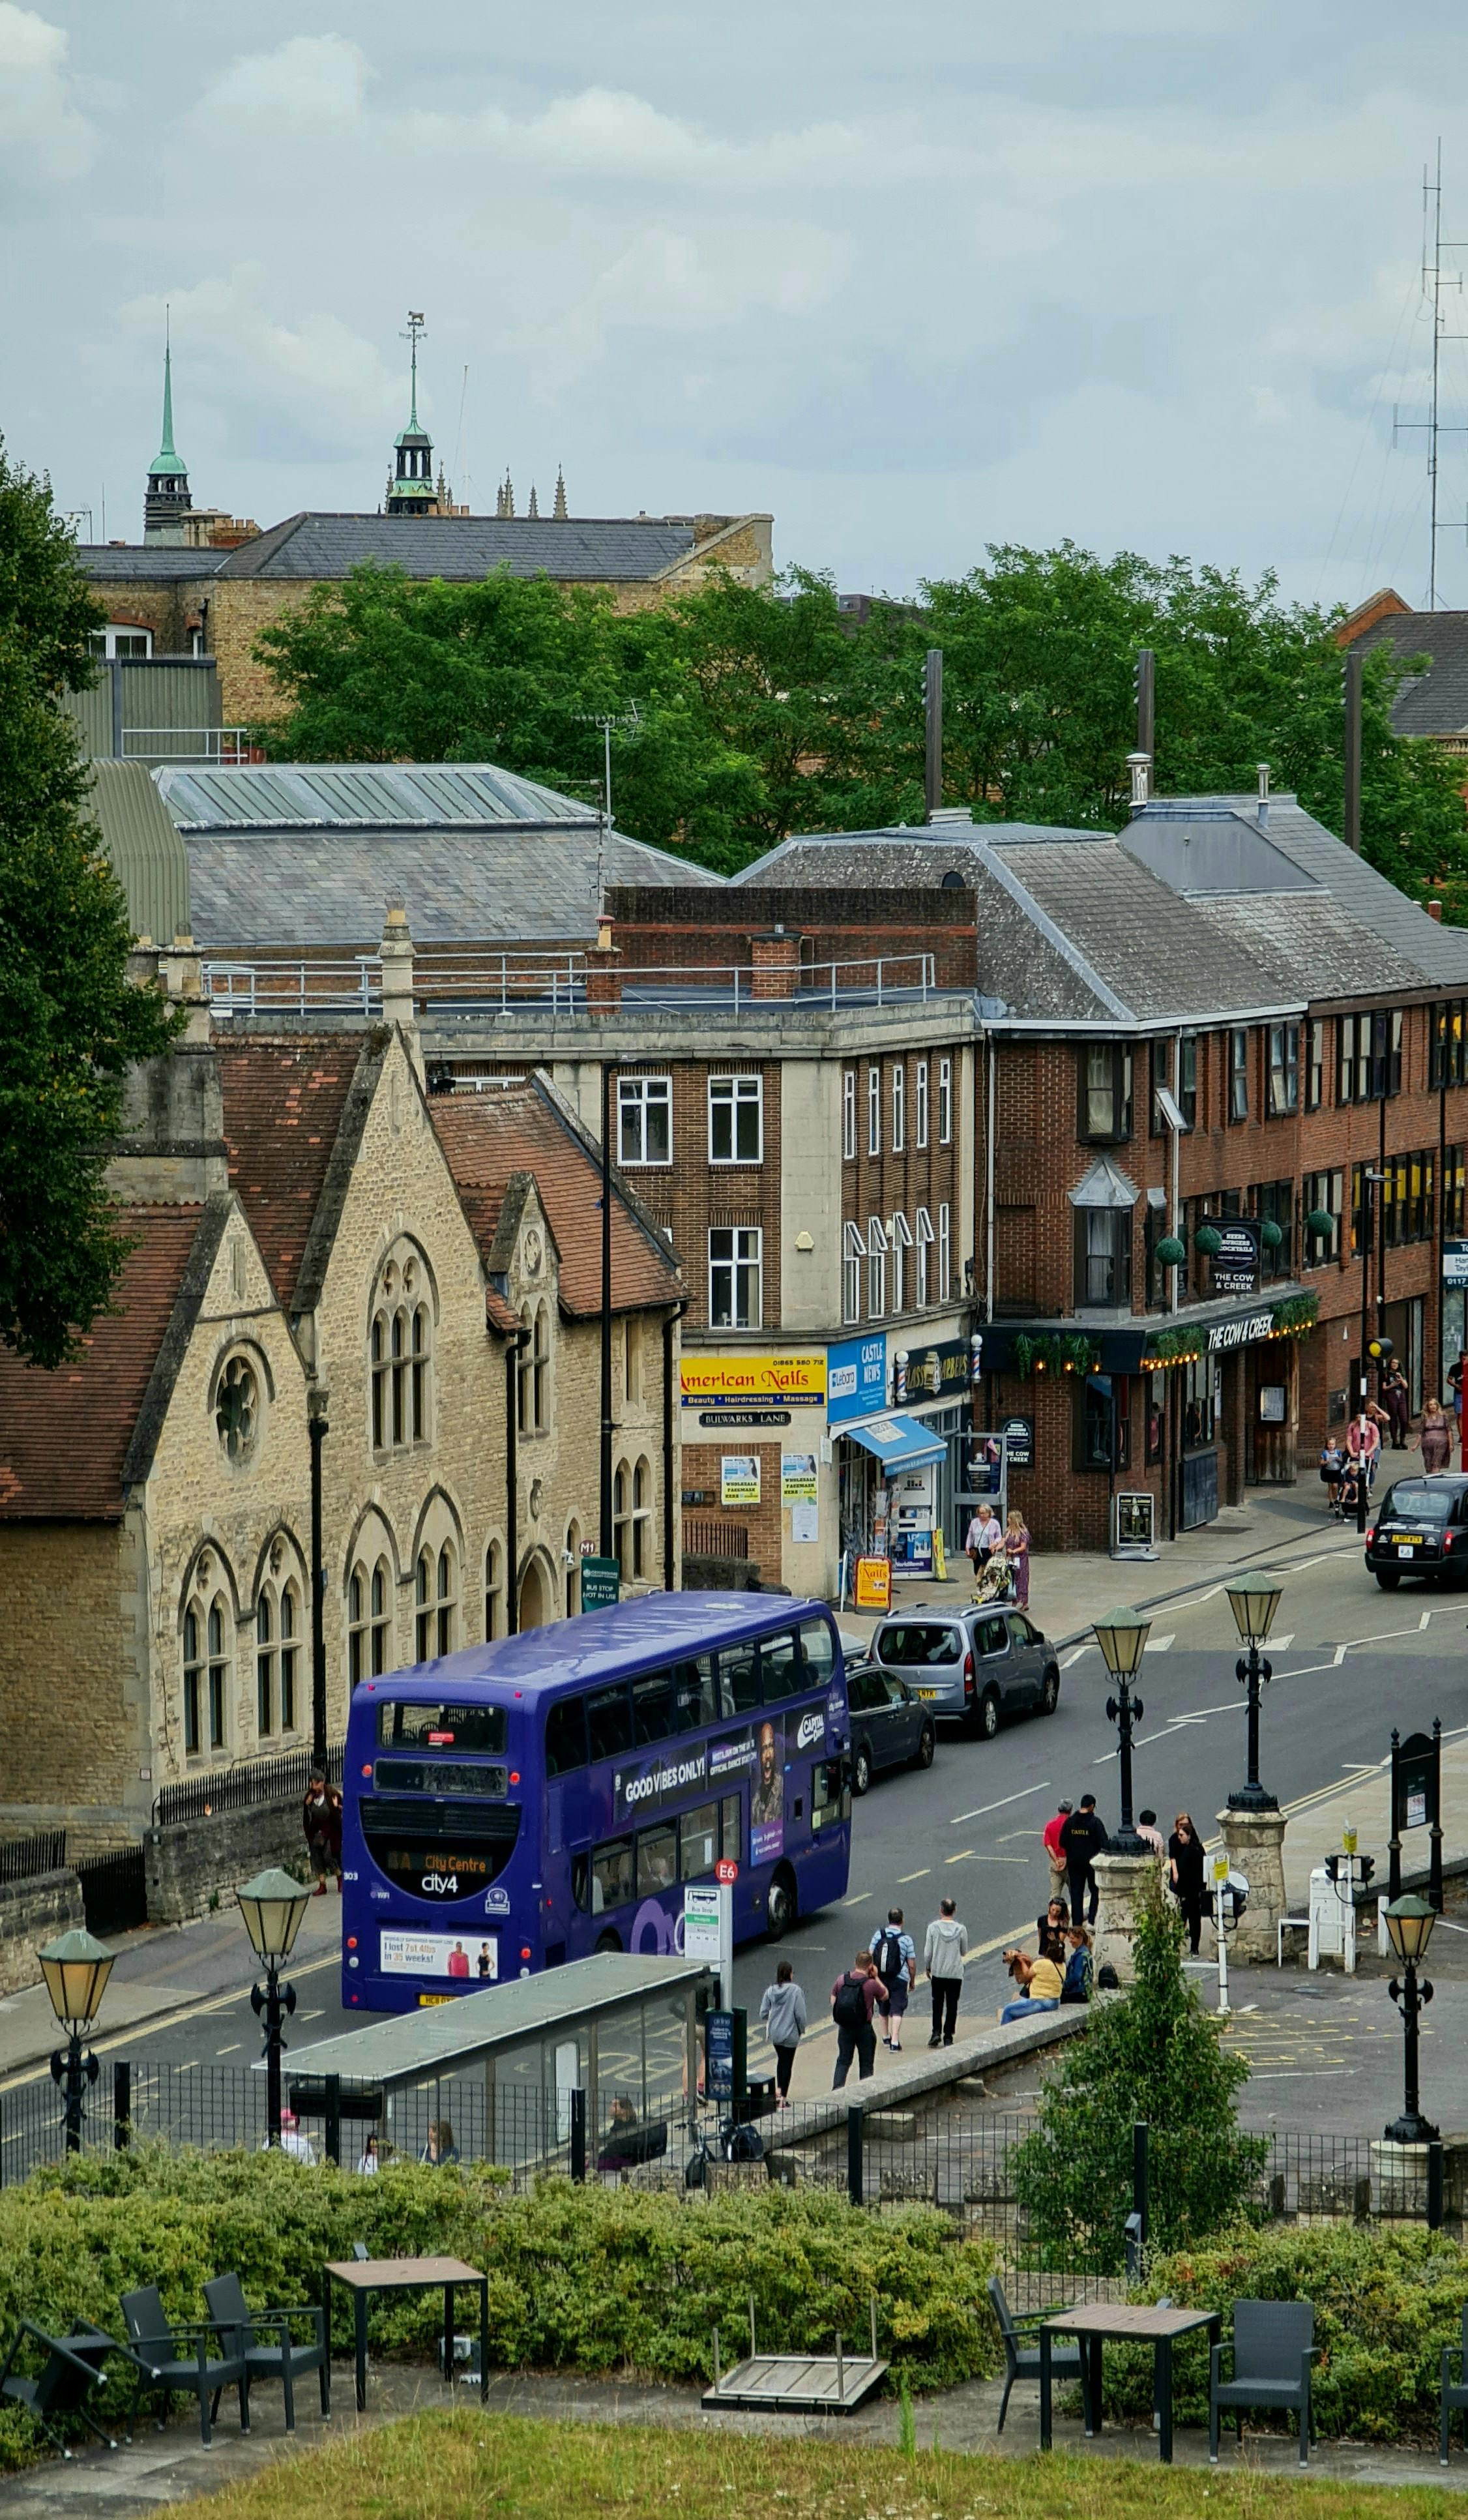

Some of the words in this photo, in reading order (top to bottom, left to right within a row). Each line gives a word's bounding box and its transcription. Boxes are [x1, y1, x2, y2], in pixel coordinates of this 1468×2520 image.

[1208, 1326, 1224, 1350] THE
[1224, 1321, 1244, 1346] COW
[1242, 1320, 1248, 1342] &
[1249, 1314, 1274, 1340] CREEK
[862, 1342, 883, 1363] CASTLE
[761, 1370, 809, 1390] Nails
[864, 1363, 881, 1384] NEWS
[725, 1395, 774, 1404] Hairdressing
[705, 1415, 753, 1423] BULWARKS
[580, 1543, 594, 1553] M1
[860, 1567, 887, 1580] Nails
[803, 1714, 825, 1734] CAPITAL
[626, 1776, 653, 1802] GOOD
[653, 1766, 677, 1792] VIBES
[678, 1757, 705, 1784] ONLY!
[426, 1854, 447, 1872] City
[448, 1856, 486, 1873] Centre
[720, 1865, 735, 1878] E6
[421, 1873, 458, 1893] city4
[389, 1942, 403, 1951] lost
[385, 1951, 392, 1960] in
[405, 1954, 433, 1963] weeks!
